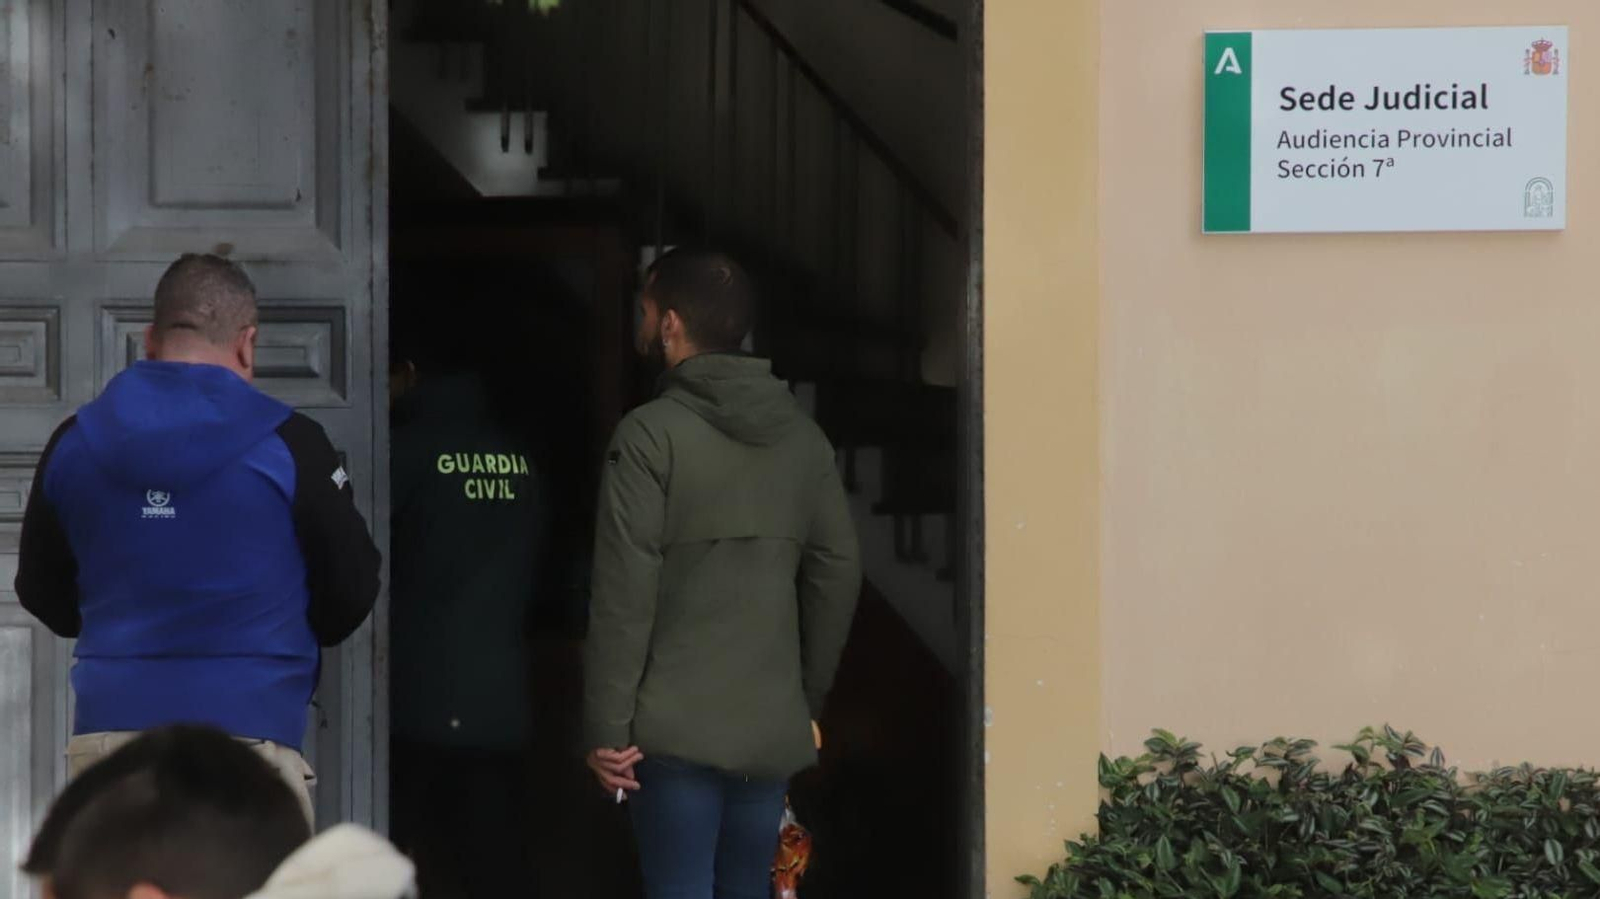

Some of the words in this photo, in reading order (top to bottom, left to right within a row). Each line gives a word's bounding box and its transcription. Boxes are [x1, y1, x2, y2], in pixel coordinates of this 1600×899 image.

[1279, 85, 1356, 111] Sede
[1364, 83, 1488, 111] Judicial
[1277, 128, 1390, 149] Audiencia
[1397, 127, 1512, 148] Provincial
[1277, 156, 1365, 179] Sección
[1372, 157, 1395, 178] 7ª
[437, 453, 529, 476] GUARDIA
[464, 478, 515, 500] CIVIL
